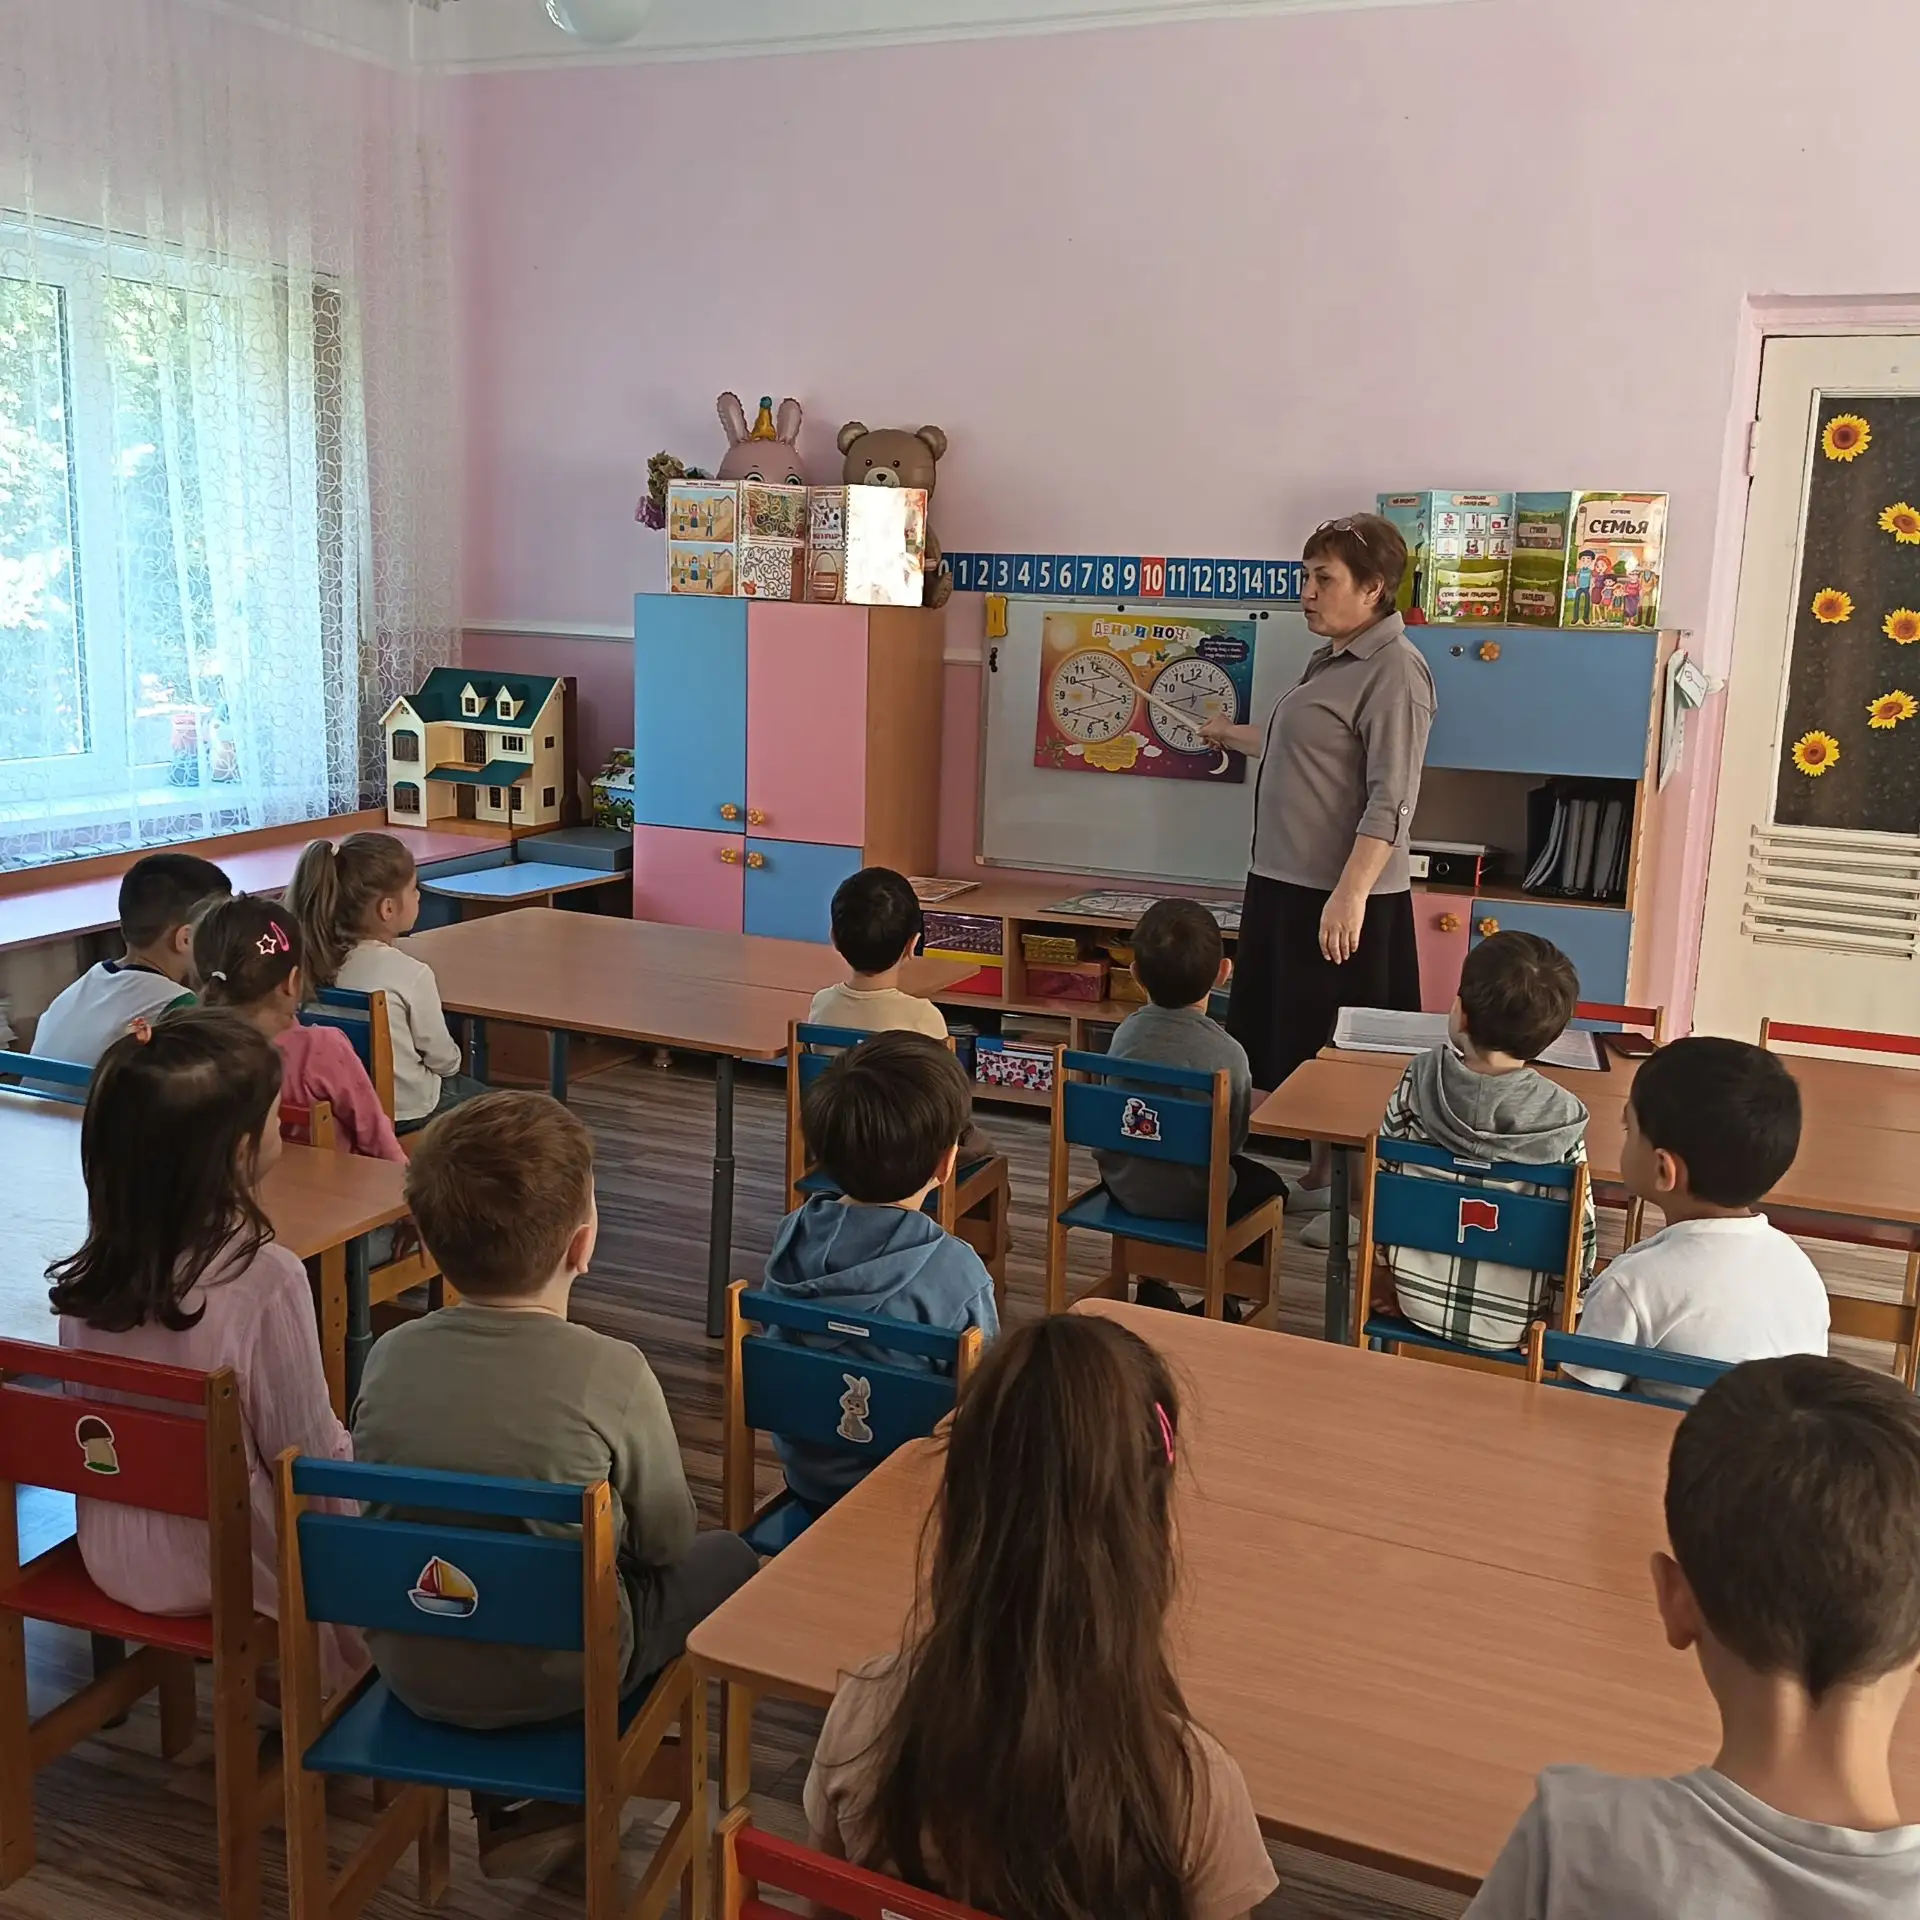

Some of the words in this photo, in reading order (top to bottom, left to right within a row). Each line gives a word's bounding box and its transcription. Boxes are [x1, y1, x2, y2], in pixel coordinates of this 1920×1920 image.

[1589, 519, 1649, 534] СЕМЬЯ
[959, 560, 967, 585] 1
[977, 560, 989, 586] 2
[997, 560, 1008, 586] 3
[1017, 561, 1030, 587] 4
[1039, 561, 1051, 588] 5
[1059, 562, 1072, 588] 6
[1081, 563, 1093, 589] 7
[1101, 563, 1114, 590] 8
[1123, 564, 1136, 590] 9
[1143, 564, 1163, 591] 10
[1168, 564, 1185, 591] 11
[1192, 565, 1212, 592] 12
[1216, 566, 1237, 593] 13
[1241, 567, 1263, 594] 14
[1266, 568, 1288, 595] 15
[1292, 569, 1301, 595] 1
[1135, 625, 1146, 638] И
[1075, 665, 1085, 675] 11
[1190, 668, 1202, 678] 12
[1065, 676, 1076, 685] 10
[1174, 673, 1185, 683] 11
[1164, 683, 1175, 693] 10
[1218, 687, 1225, 696] 2
[1059, 690, 1066, 700] 9
[1120, 695, 1127, 704] 3
[1062, 707, 1069, 717] 8
[1222, 703, 1228, 712] 3
[1114, 711, 1121, 720] 4
[1161, 716, 1168, 725] 8
[1087, 723, 1093, 734] 6
[1103, 721, 1109, 731] 5
[1187, 732, 1193, 743] 6
